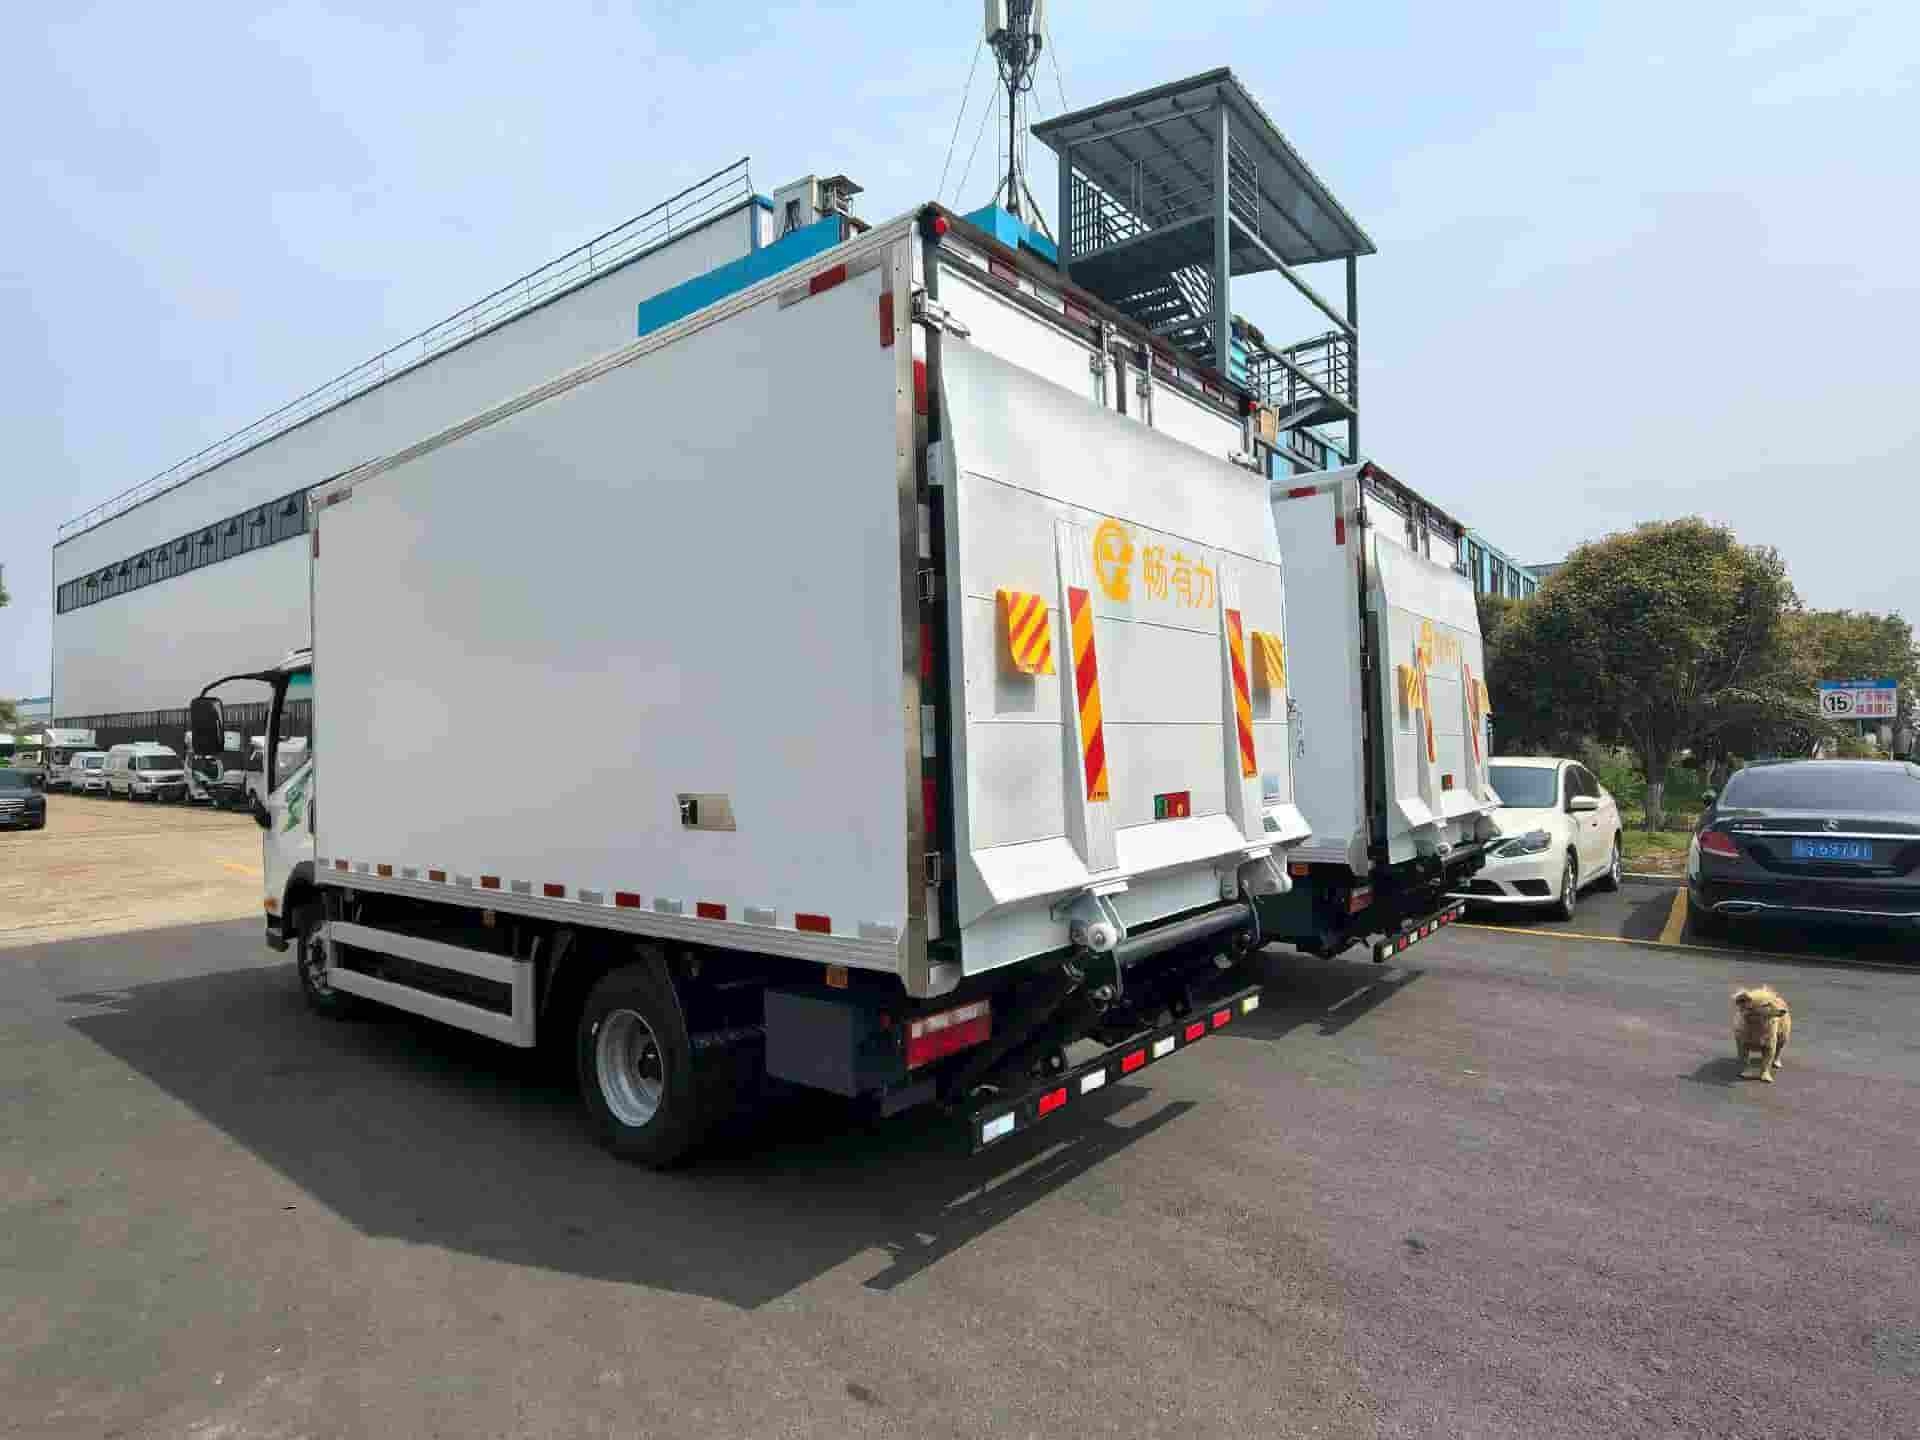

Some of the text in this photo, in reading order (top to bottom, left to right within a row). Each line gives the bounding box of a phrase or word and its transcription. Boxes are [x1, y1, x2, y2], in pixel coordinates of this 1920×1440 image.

[1142, 543, 1216, 609] 畅有力
[1828, 695, 1848, 712] 15
